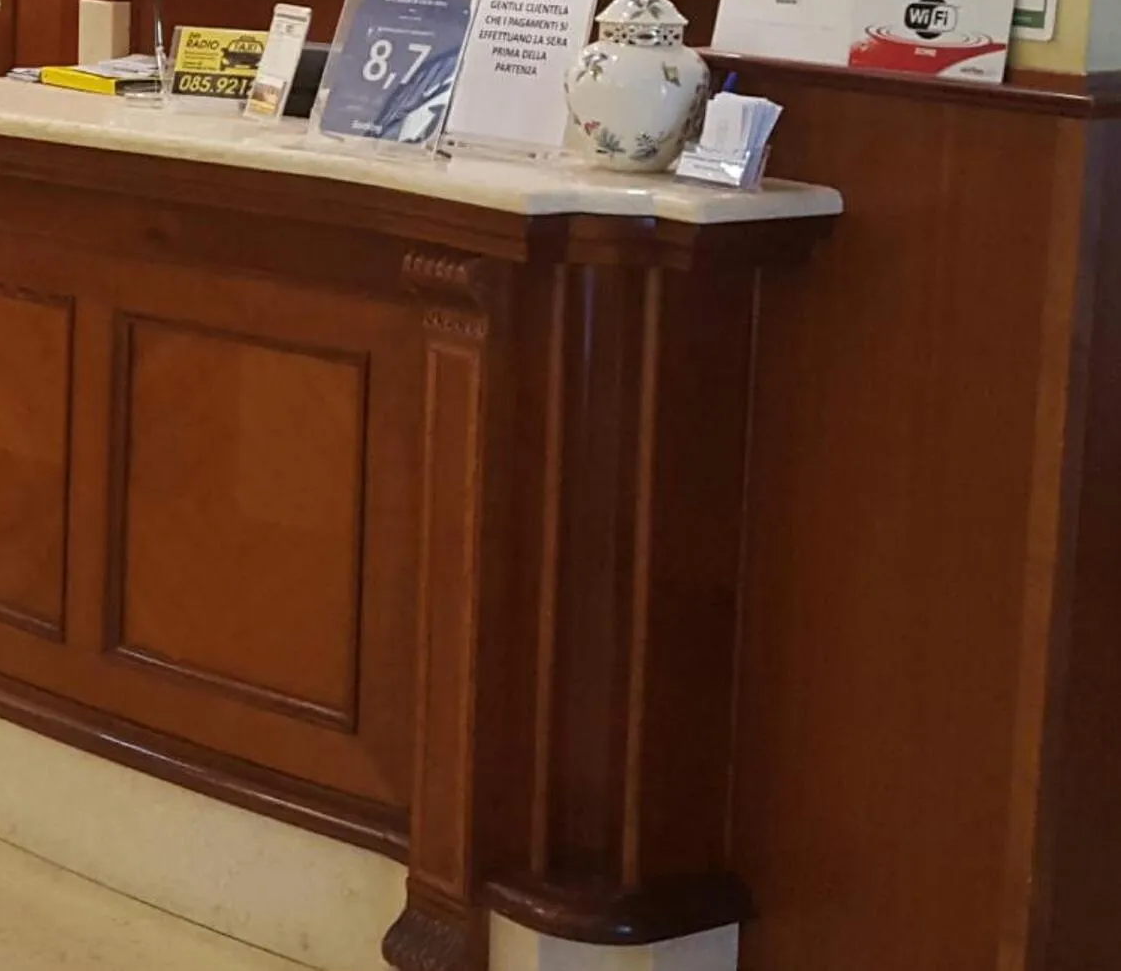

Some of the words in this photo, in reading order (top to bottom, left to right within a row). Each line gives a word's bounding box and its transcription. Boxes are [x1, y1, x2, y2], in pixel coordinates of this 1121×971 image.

[490, 0, 524, 11] GENTILE
[525, 3, 569, 15] CLIENTELA
[485, 15, 501, 25] CHE
[508, 16, 559, 30] PAGAMENTI
[559, 21, 569, 31] SI
[186, 38, 219, 50] RADIO
[478, 29, 532, 43] EFFETTUANO
[533, 34, 544, 44] LA
[545, 36, 567, 46] SERA
[492, 47, 520, 57] PRIMA
[522, 49, 547, 60] DELLA
[362, 39, 432, 90] 8,7
[494, 62, 538, 75] PARTENZA
